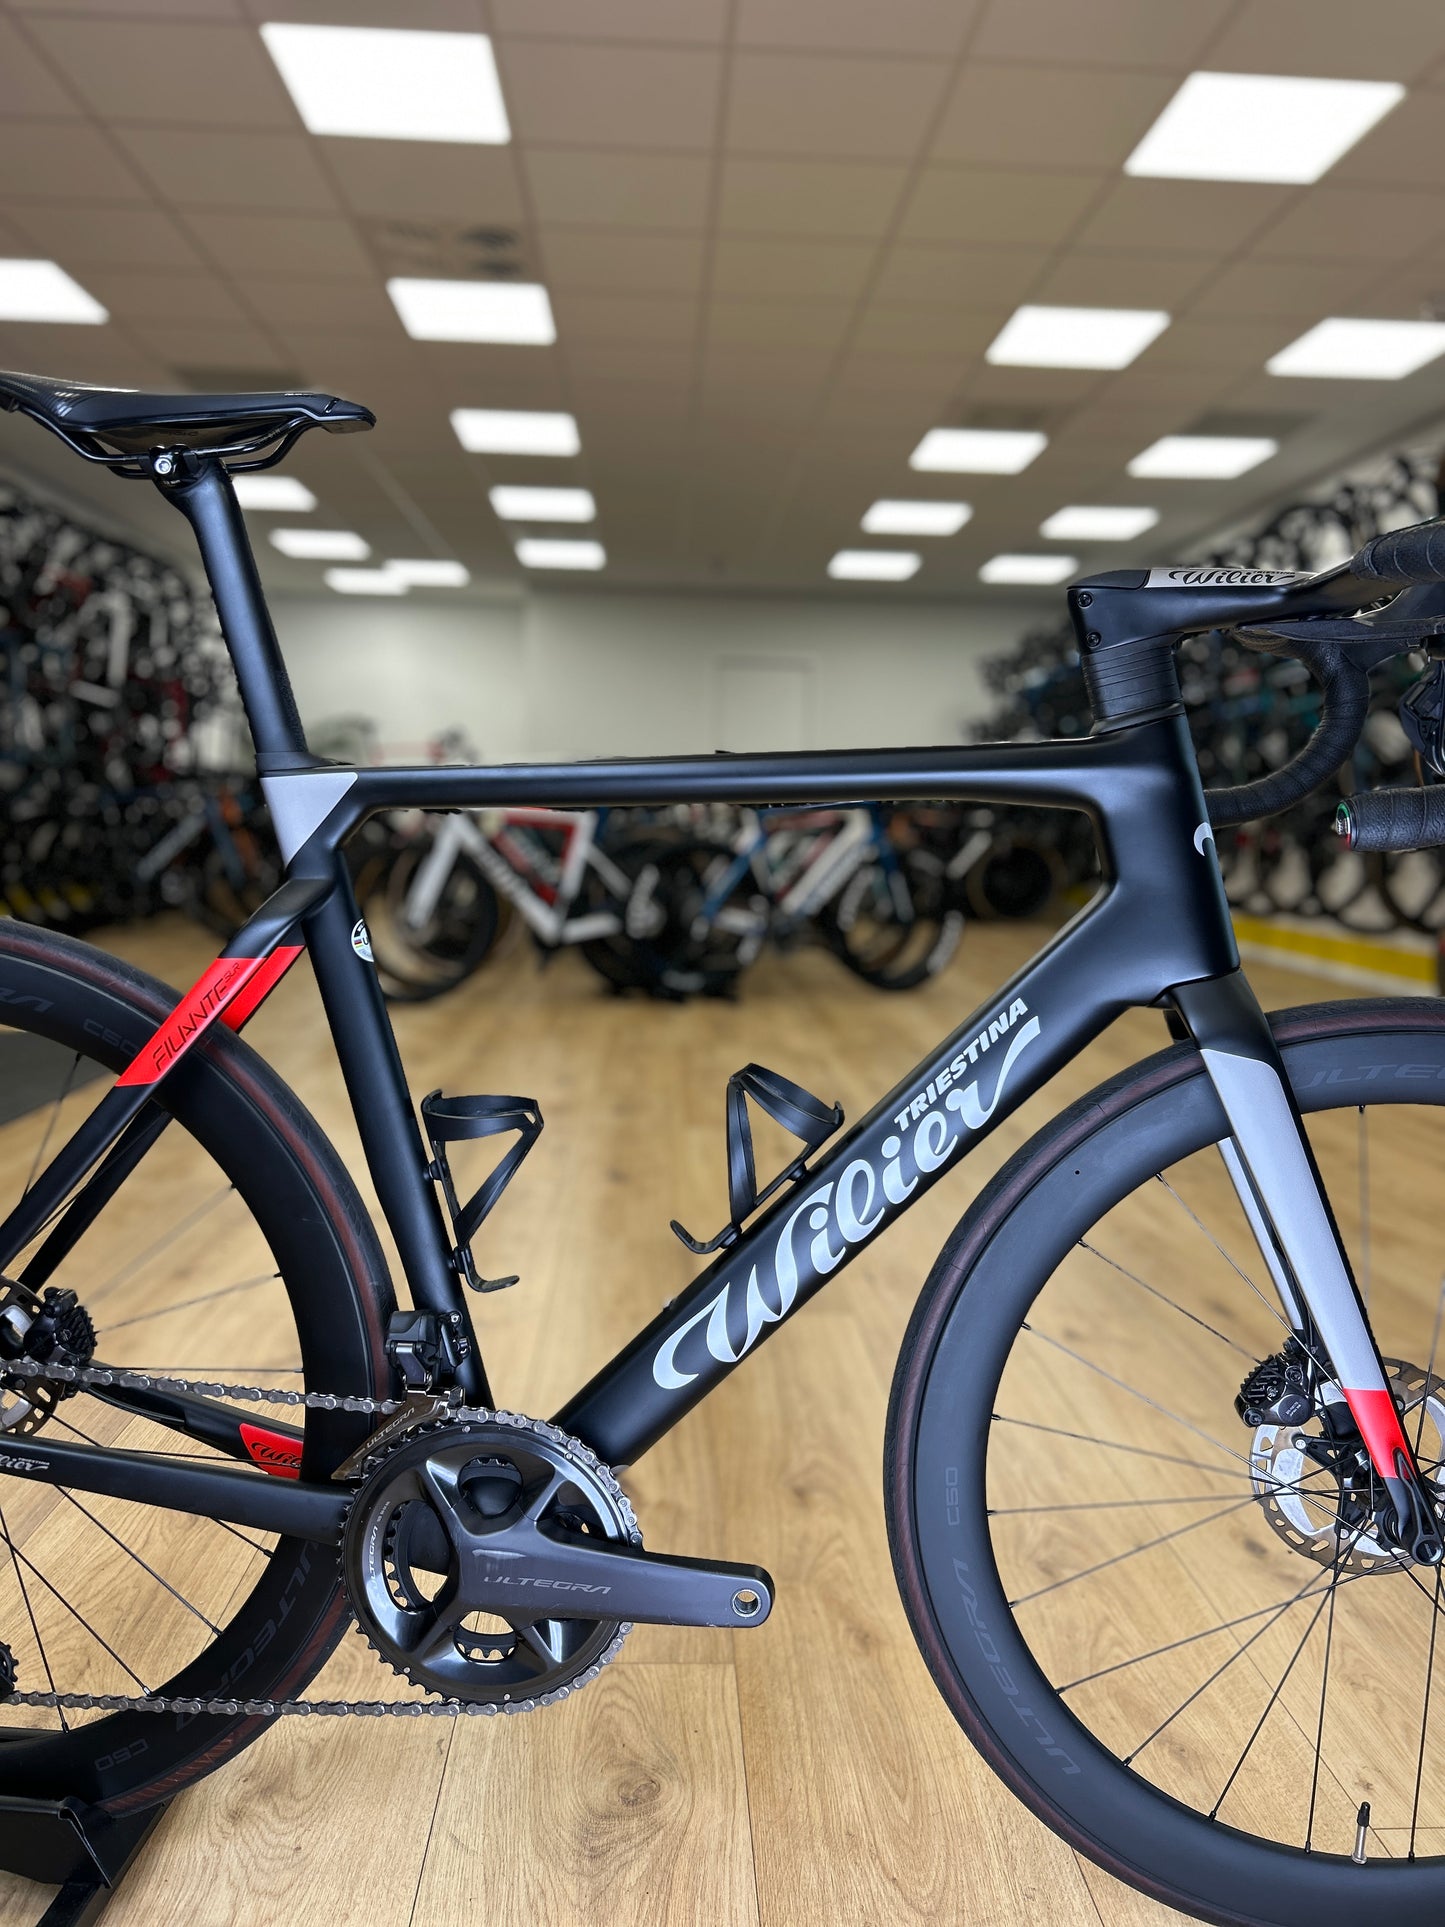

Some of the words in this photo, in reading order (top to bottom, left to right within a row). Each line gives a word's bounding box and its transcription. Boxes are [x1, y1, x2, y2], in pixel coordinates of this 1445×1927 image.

[1168, 570, 1296, 584] Wilier
[152, 978, 230, 1073] FILANTE
[893, 997, 1029, 1132] TRIESTINA
[1293, 1063, 1445, 1091] ULTE
[652, 1015, 1042, 1390] Wilier
[366, 1406, 416, 1449] ULTEGRA
[945, 1467, 960, 1526] C50
[484, 1566, 613, 1595] ULTEGRA
[952, 1557, 1082, 1775] ULTEGRA
[93, 1738, 150, 1772] C50
